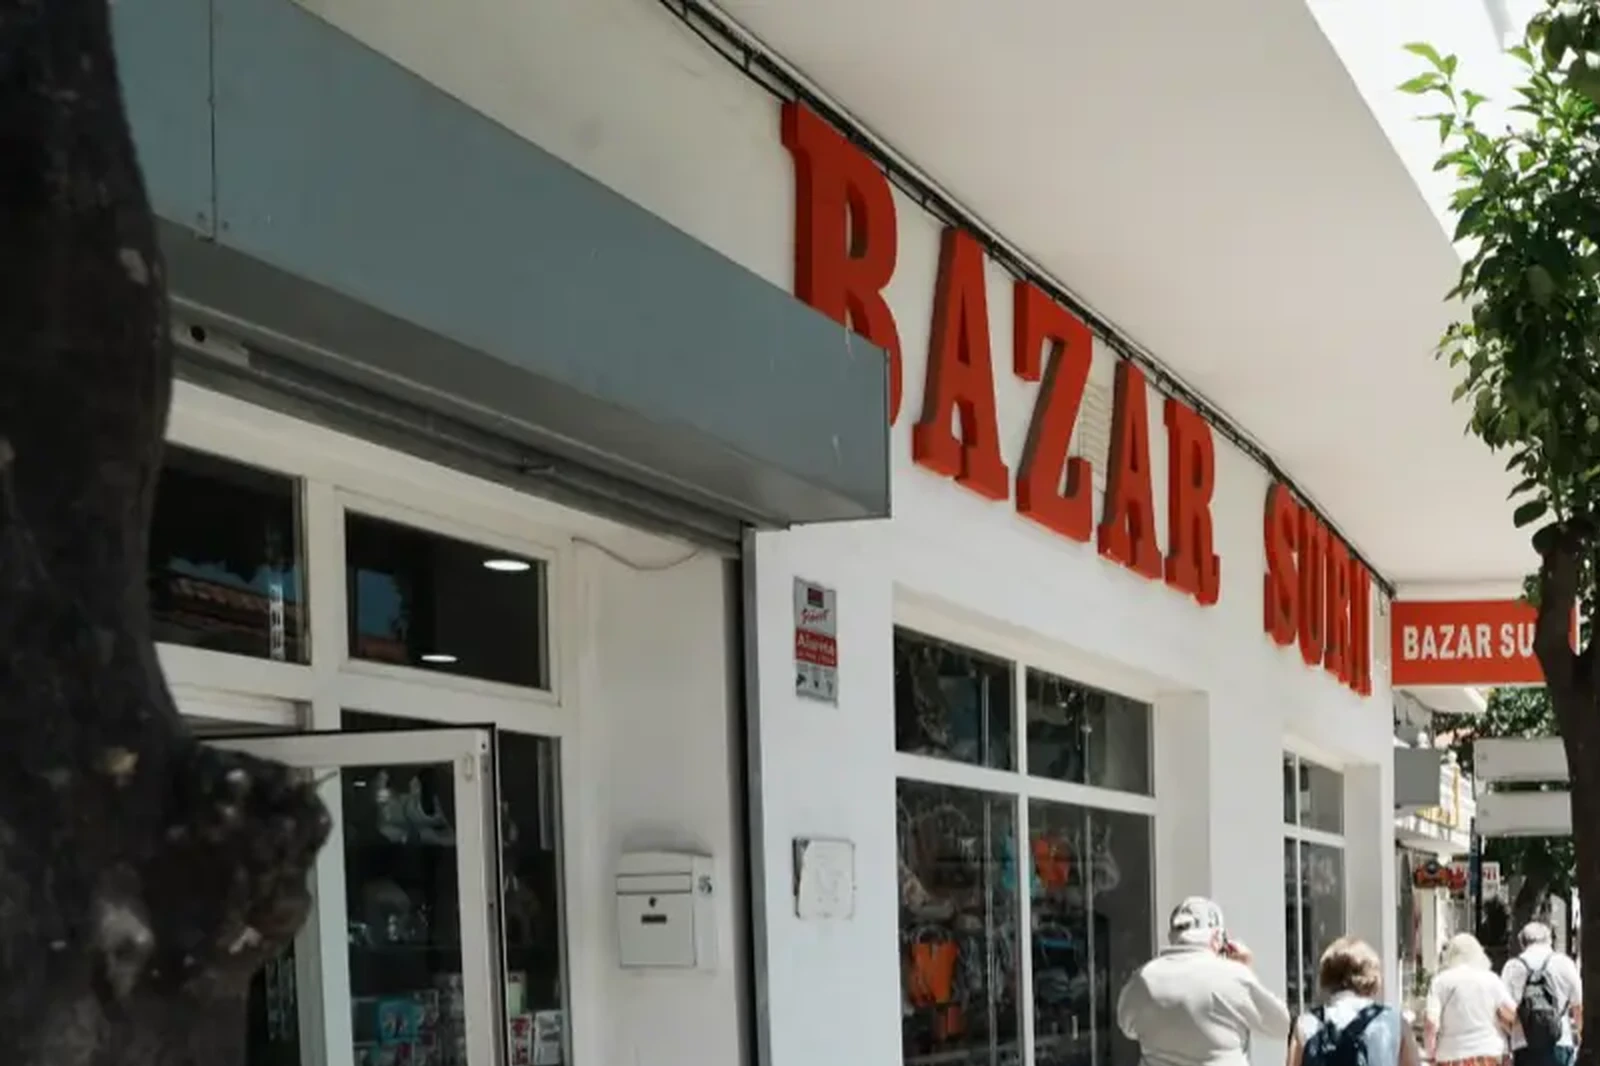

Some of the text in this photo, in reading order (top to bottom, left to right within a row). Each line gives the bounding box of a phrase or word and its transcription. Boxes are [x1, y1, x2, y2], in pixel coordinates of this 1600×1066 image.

[781, 99, 1372, 697] BAZAR SURI
[1403, 622, 1537, 661] BAZAR SU
